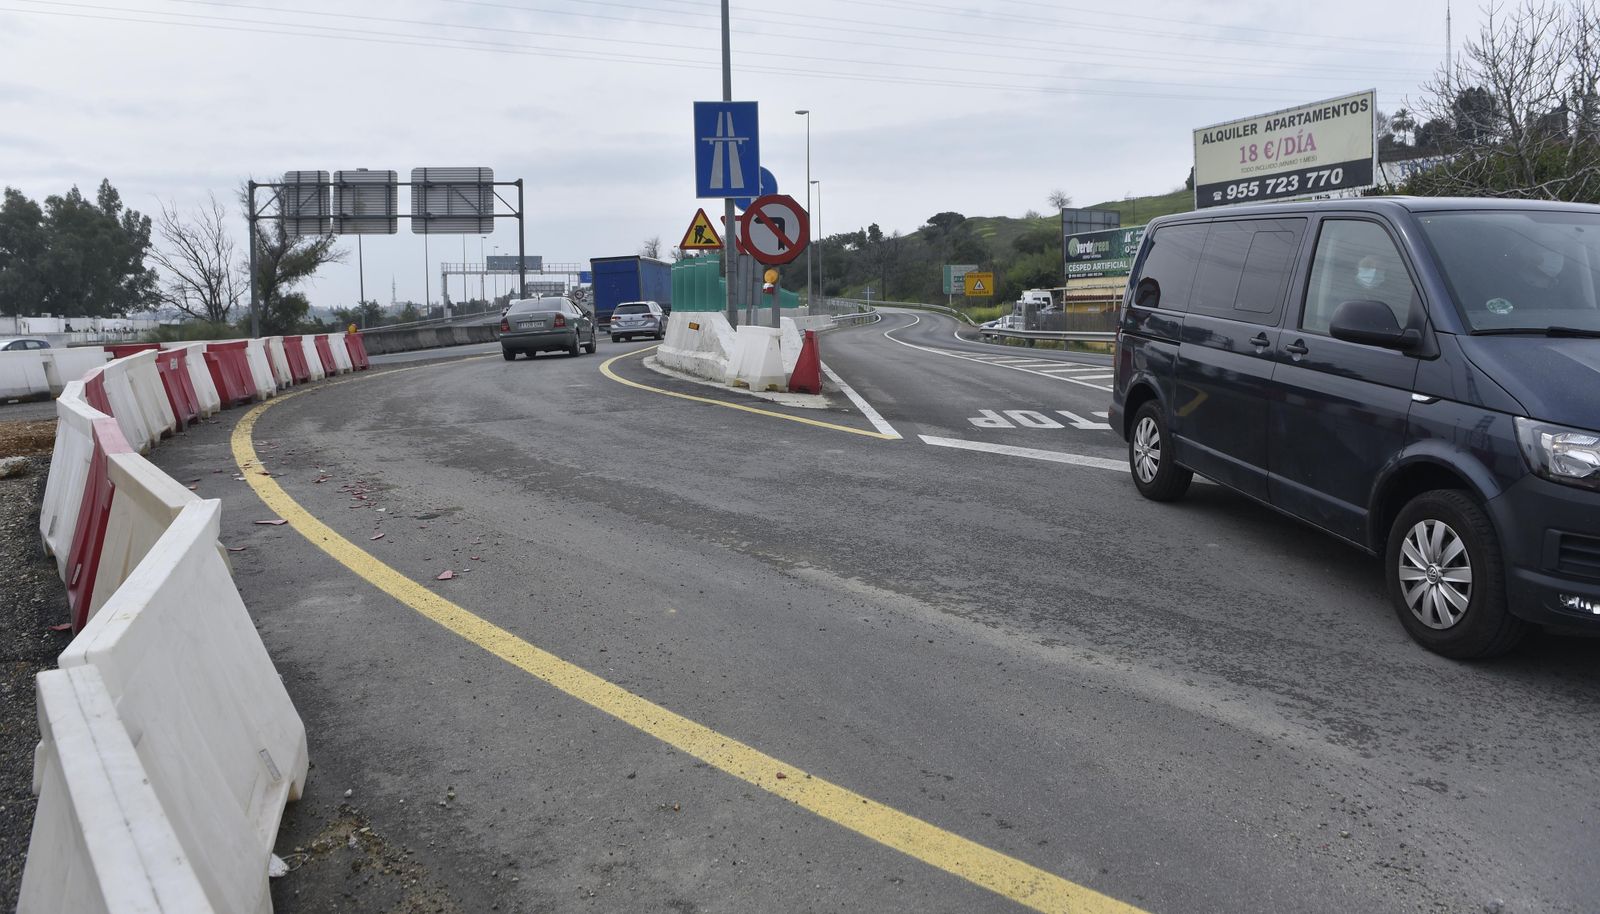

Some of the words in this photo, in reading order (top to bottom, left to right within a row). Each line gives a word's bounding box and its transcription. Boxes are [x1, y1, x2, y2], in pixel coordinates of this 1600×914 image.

[1202, 123, 1258, 145] ALQUILER
[1264, 98, 1369, 132] APARTAMENTOS
[1240, 143, 1258, 164] 18
[1263, 129, 1317, 161] €/DÍA
[1226, 181, 1260, 200] 955
[1265, 174, 1299, 195] 723
[1306, 167, 1344, 189] 770
[1068, 262, 1092, 272] CÉSPED
[1092, 260, 1128, 270] ARTIFICIAL
[967, 409, 1112, 430] TOP
